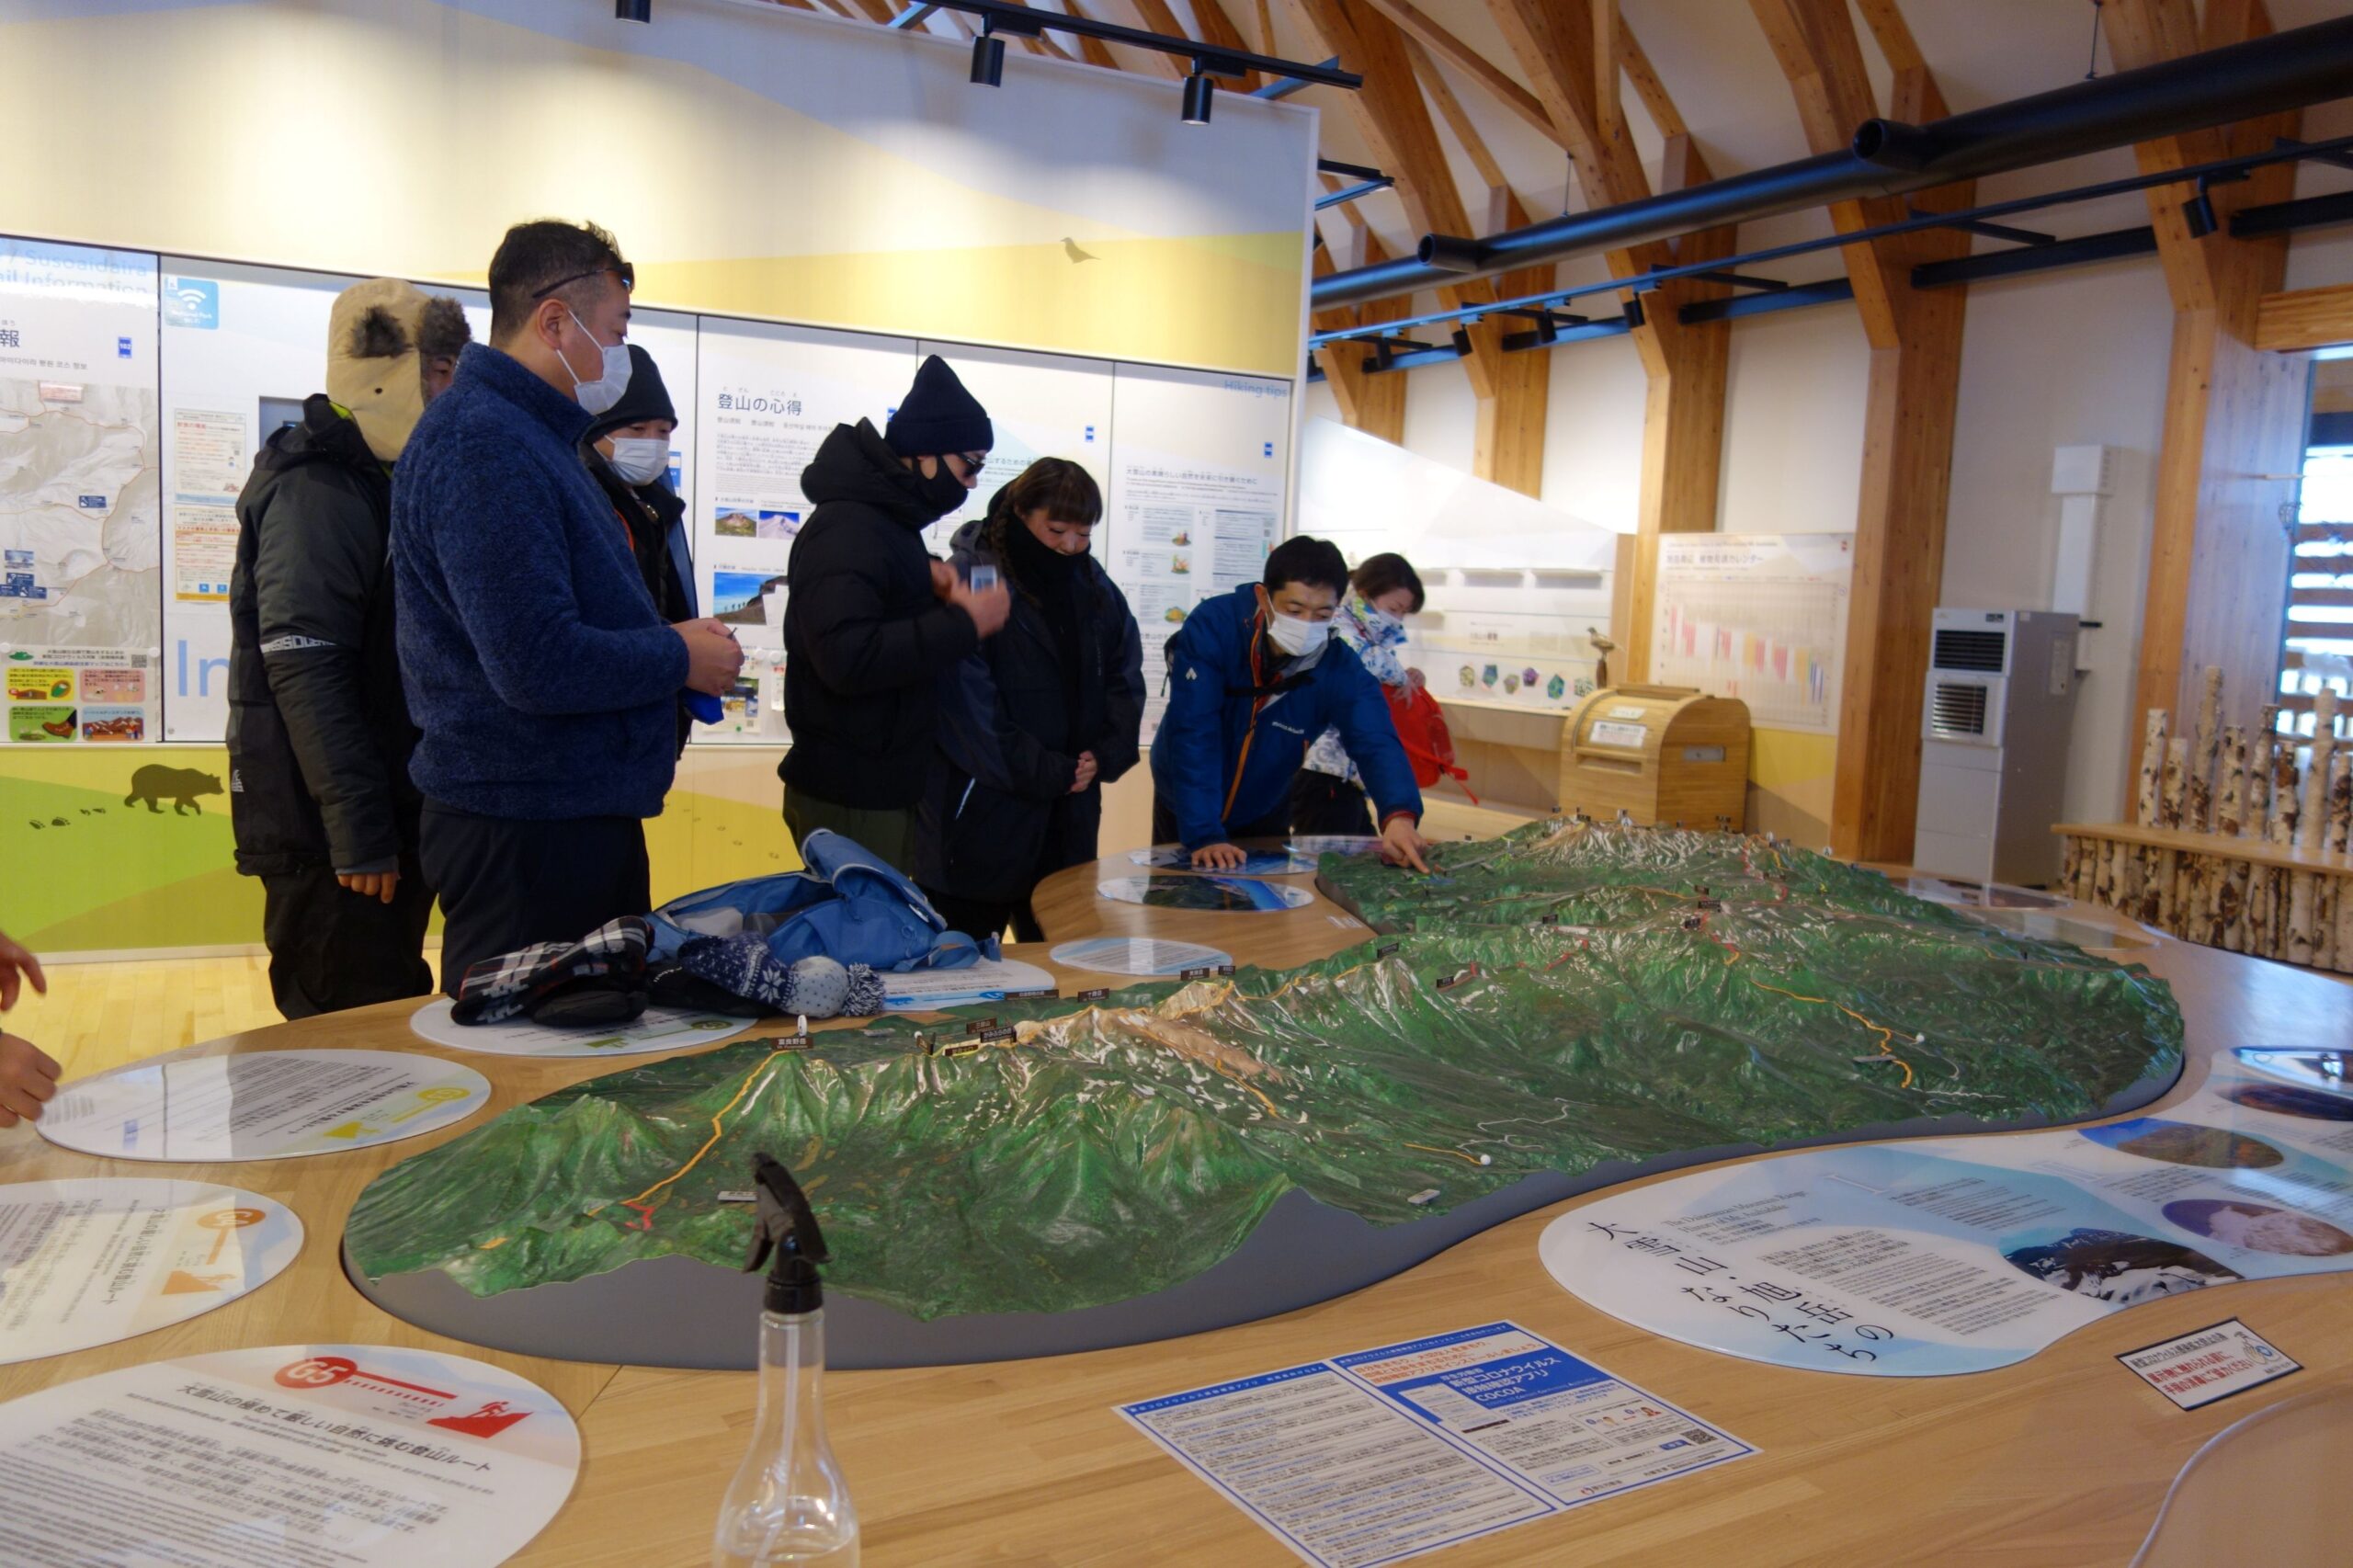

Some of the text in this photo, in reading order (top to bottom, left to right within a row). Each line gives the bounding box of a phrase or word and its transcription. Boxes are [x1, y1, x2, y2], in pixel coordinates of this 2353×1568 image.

[1223, 380, 1288, 401] Hiking tips
[718, 392, 802, 416] 登山の心得
[1681, 1286, 1877, 1362] なりたち
[287, 1360, 348, 1384] G5
[1449, 1357, 1562, 1387] 新型コロナウイルス
[1461, 1368, 1550, 1395] 接触確認アプリ
[1476, 1386, 1527, 1403] COCOA
[176, 1382, 492, 1471] 大雪山の極めて厳しい自然に挑む登山ルート
